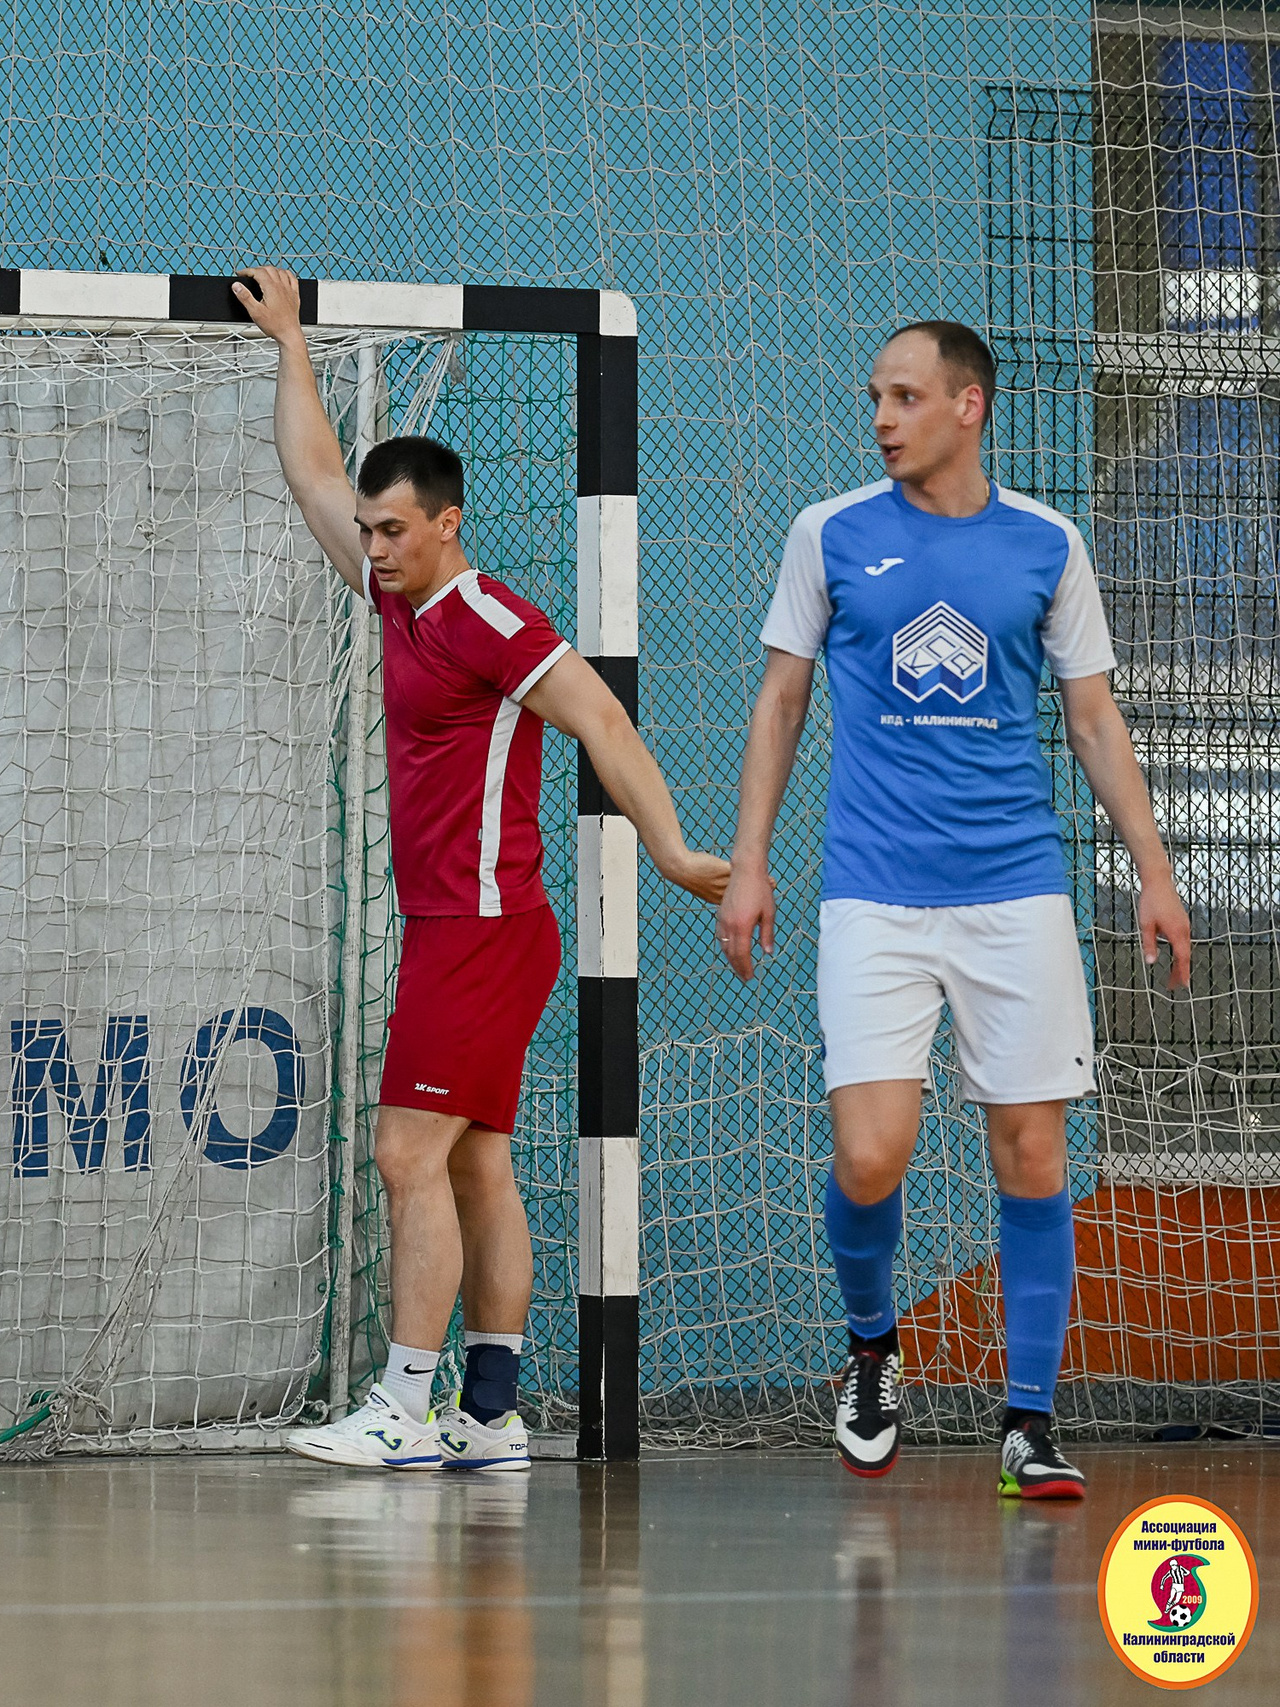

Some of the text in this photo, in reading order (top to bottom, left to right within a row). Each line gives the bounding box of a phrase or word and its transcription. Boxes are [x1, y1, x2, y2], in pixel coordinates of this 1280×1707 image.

[913, 715, 998, 730] КАЛИНИНГРАД
[414, 1083, 449, 1095] 2K SPORT
